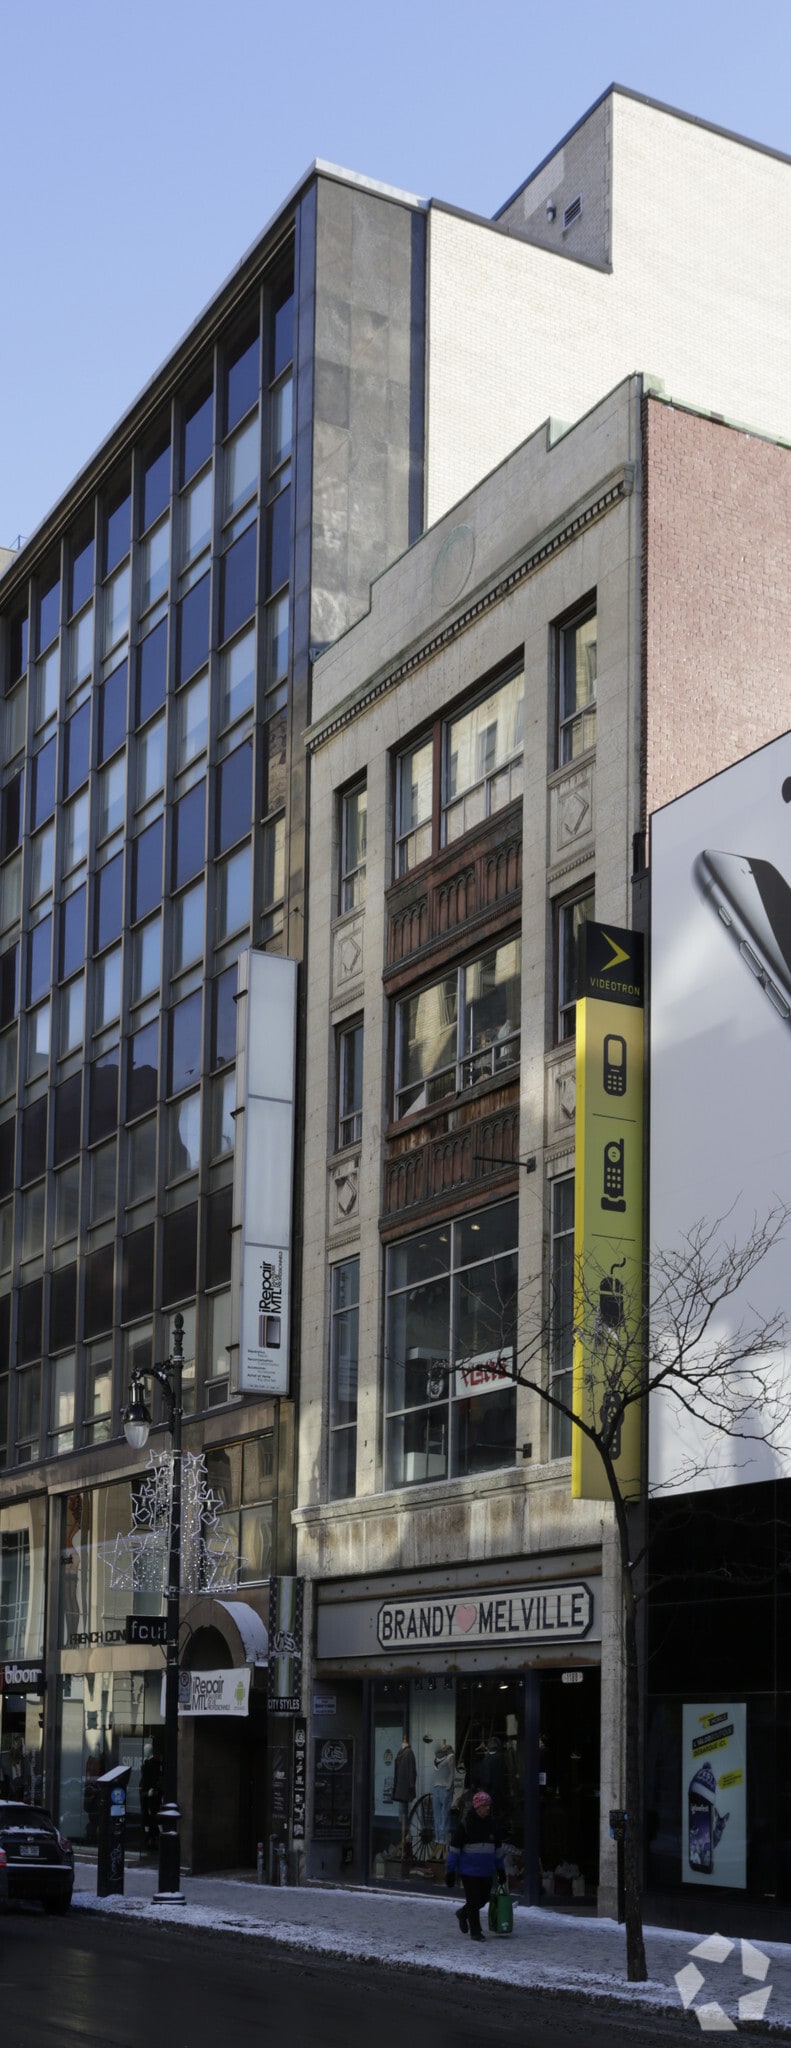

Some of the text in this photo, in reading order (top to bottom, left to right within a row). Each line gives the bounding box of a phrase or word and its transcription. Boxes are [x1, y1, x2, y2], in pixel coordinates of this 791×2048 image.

[258, 1261, 274, 1313] iRepair
[270, 1289, 282, 1314] MTL
[382, 1593, 584, 1641] BRANDY MELVILLE
[70, 1631, 103, 1645] FRENCH
[192, 1675, 225, 1697] iRepair
[192, 1694, 208, 1711] MTL
[267, 1698, 300, 1710] CITY STYLES
[122, 1756, 145, 1771] SOLDE
